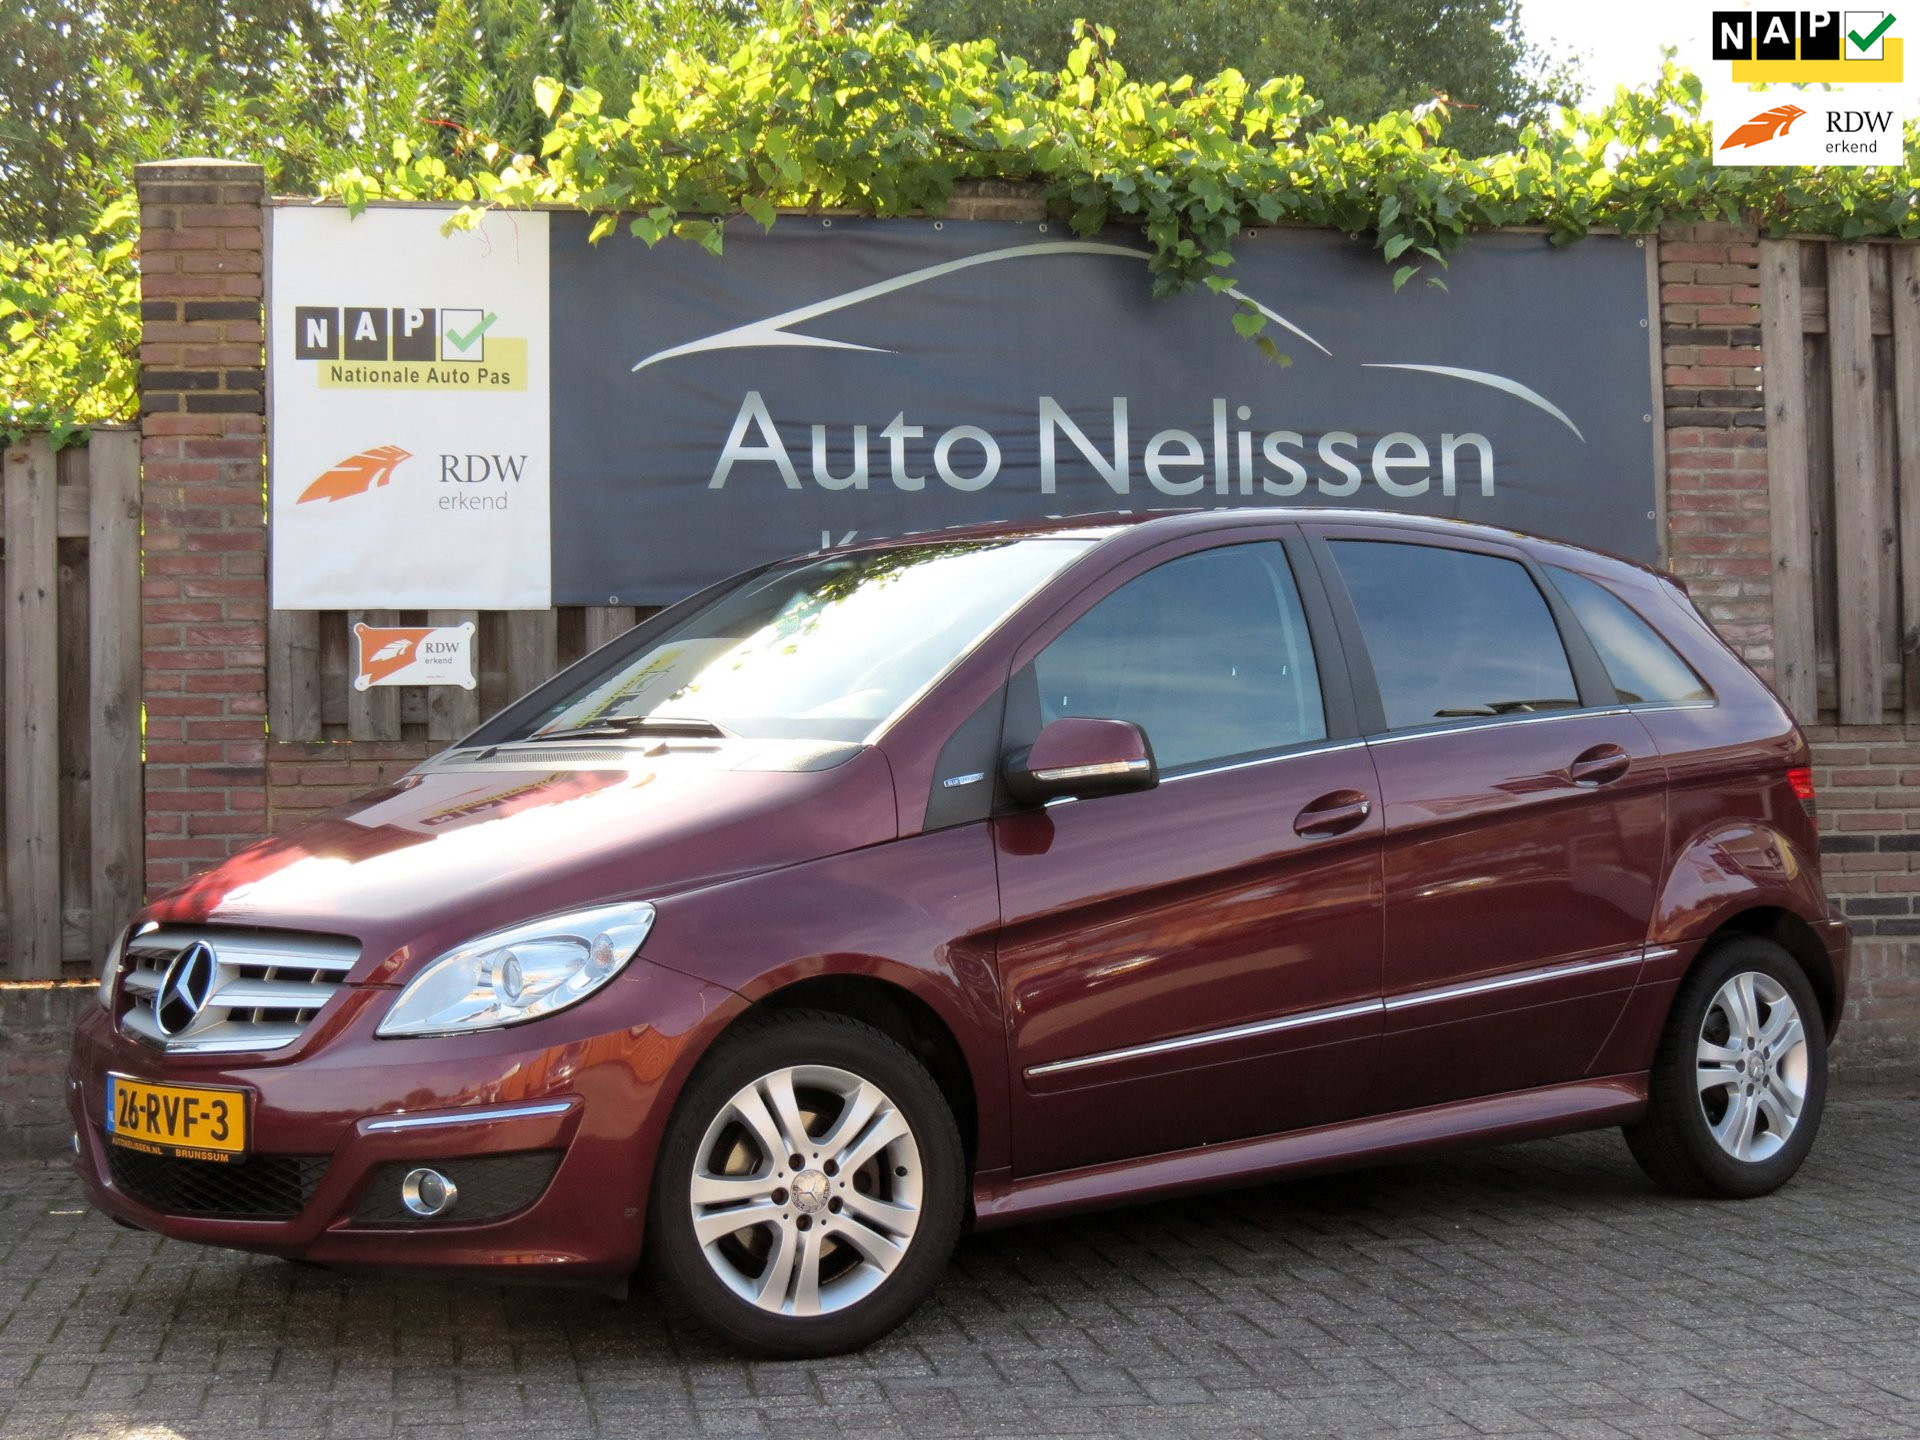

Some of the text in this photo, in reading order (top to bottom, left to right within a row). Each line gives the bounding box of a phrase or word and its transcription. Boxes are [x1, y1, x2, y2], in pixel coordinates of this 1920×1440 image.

[306, 307, 425, 348] NAP
[331, 365, 511, 385] Nationale Auto Pas
[708, 391, 1495, 498] Auto Nelissen
[439, 454, 529, 483] RDW
[439, 491, 508, 510] erkend
[425, 642, 460, 654] RDW
[425, 656, 453, 665] erkend
[118, 1087, 229, 1142] 26-RVF-3
[175, 1148, 229, 1162] BRUNSSUM
